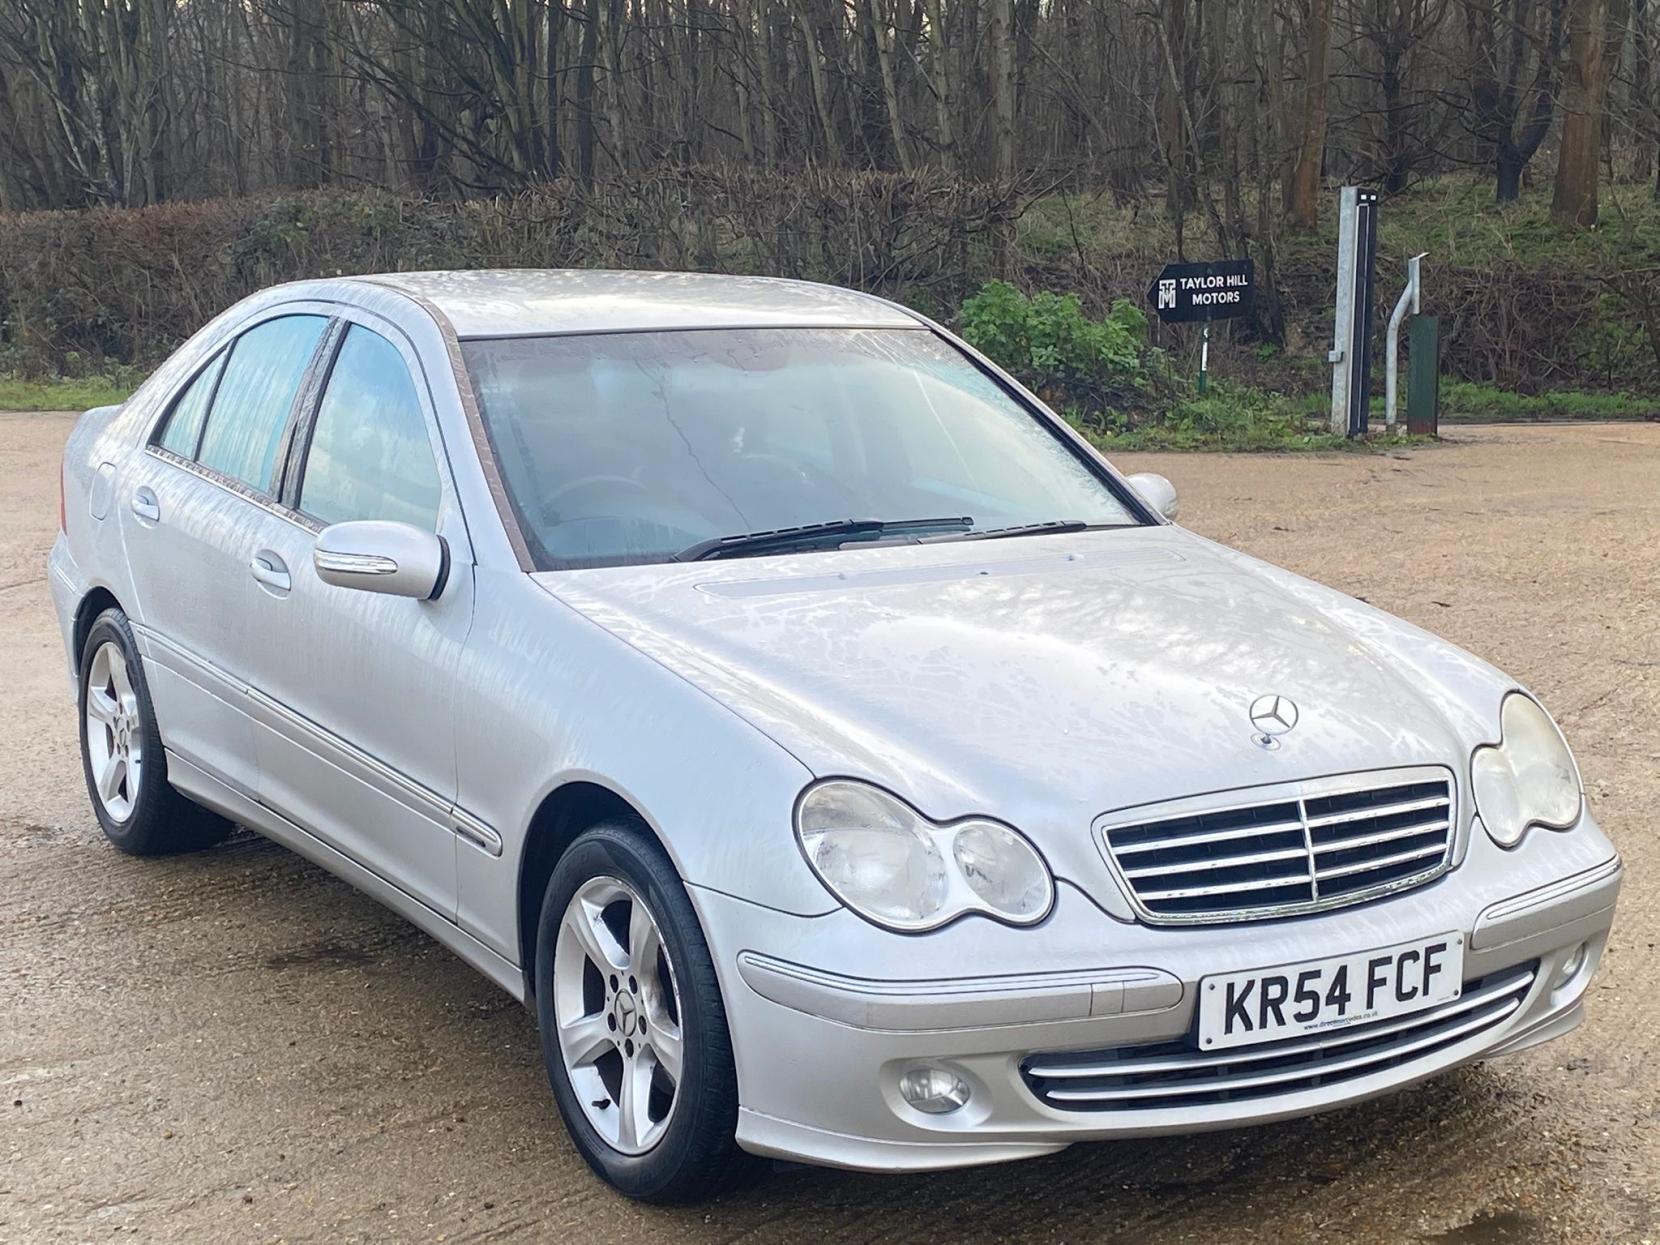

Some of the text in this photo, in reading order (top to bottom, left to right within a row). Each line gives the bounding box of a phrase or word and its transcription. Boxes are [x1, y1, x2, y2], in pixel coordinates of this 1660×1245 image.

[1180, 274, 1248, 290] TAYLOR HILL
[1192, 291, 1240, 305] MOTORS
[1224, 942, 1447, 1035] KR54 FCF
